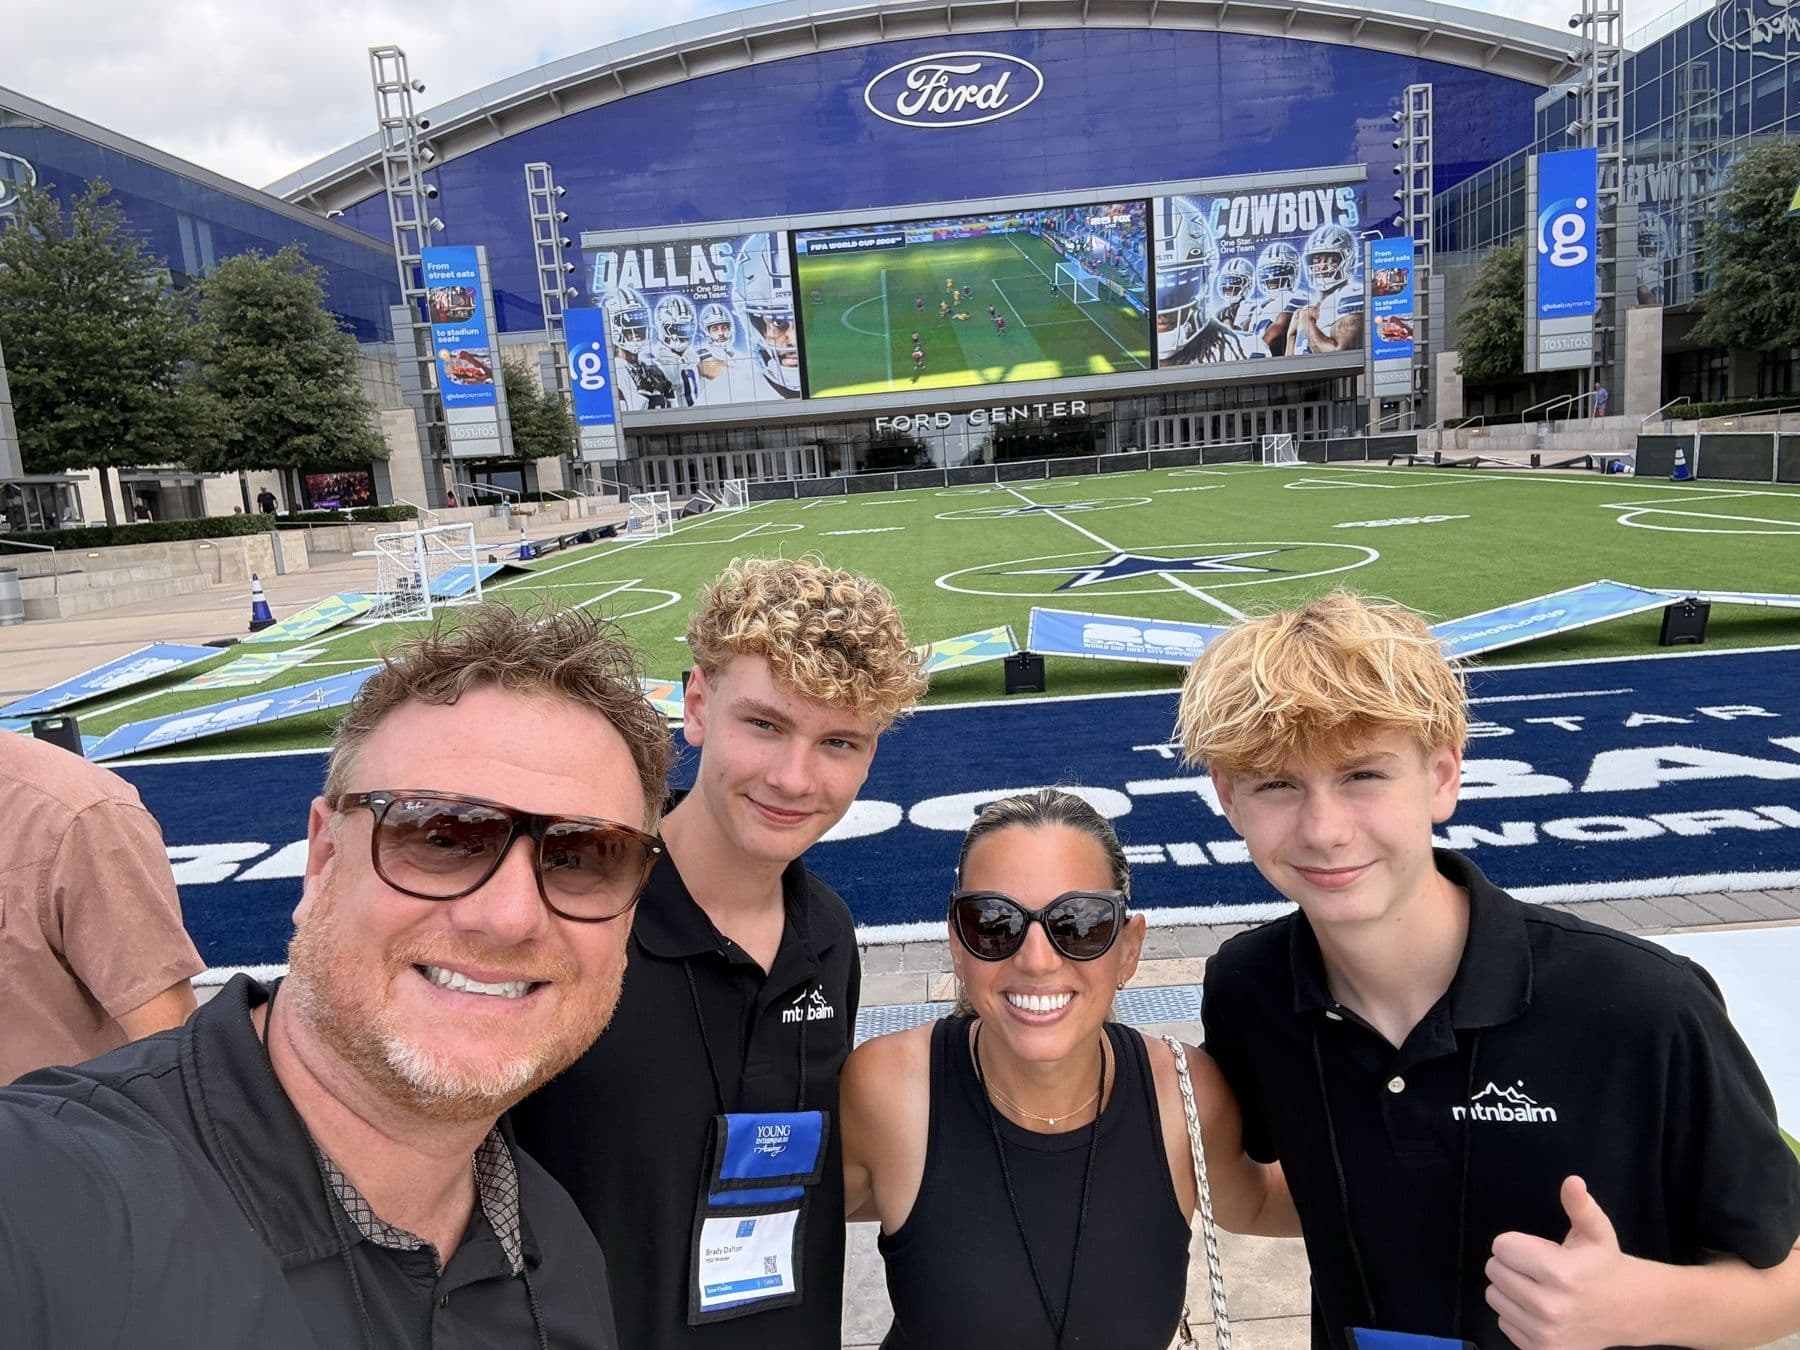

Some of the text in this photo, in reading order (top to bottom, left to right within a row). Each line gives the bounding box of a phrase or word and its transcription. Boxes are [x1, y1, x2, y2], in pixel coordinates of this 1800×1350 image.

[897, 63, 1012, 116] Ford
[1209, 187, 1360, 239] COWBOYS
[1113, 214, 1131, 223] FOX
[810, 243, 828, 251] FIFA
[829, 241, 858, 250] WORLD
[858, 239, 875, 247] CUP
[1220, 239, 1236, 247] One
[1220, 246, 1235, 254] One
[427, 262, 449, 271] From
[593, 243, 736, 293] DALLAS
[428, 270, 475, 280] street eats
[696, 284, 728, 293] One Star.
[693, 291, 729, 300] One Team.
[437, 327, 479, 337] to stadium
[438, 336, 460, 344] seats
[875, 400, 1086, 432] FORD CENTER
[757, 1124, 791, 1138] YOUNG
